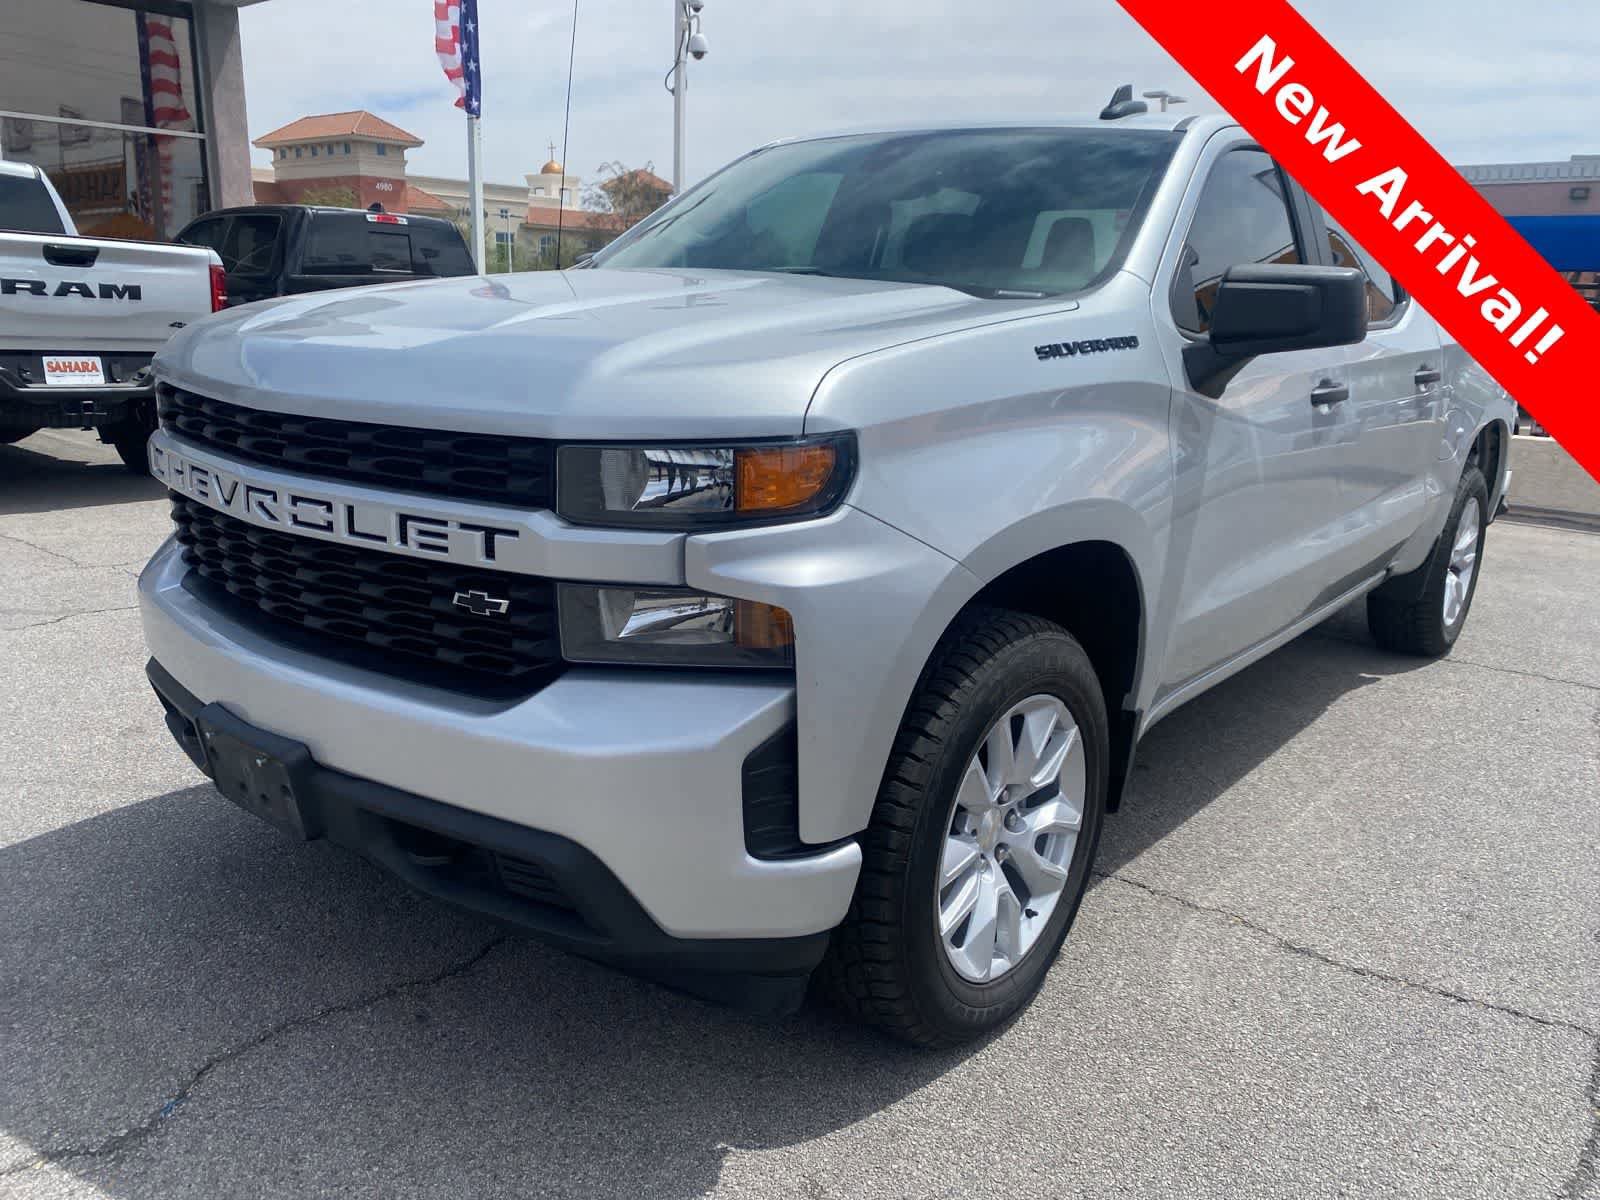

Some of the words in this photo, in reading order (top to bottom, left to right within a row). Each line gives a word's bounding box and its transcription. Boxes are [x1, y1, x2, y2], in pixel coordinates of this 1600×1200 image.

[0, 278, 142, 301] RAM
[1034, 336, 1140, 360] SILVERADO
[46, 360, 100, 373] SAHARA
[149, 446, 520, 563] CHEVROLET
